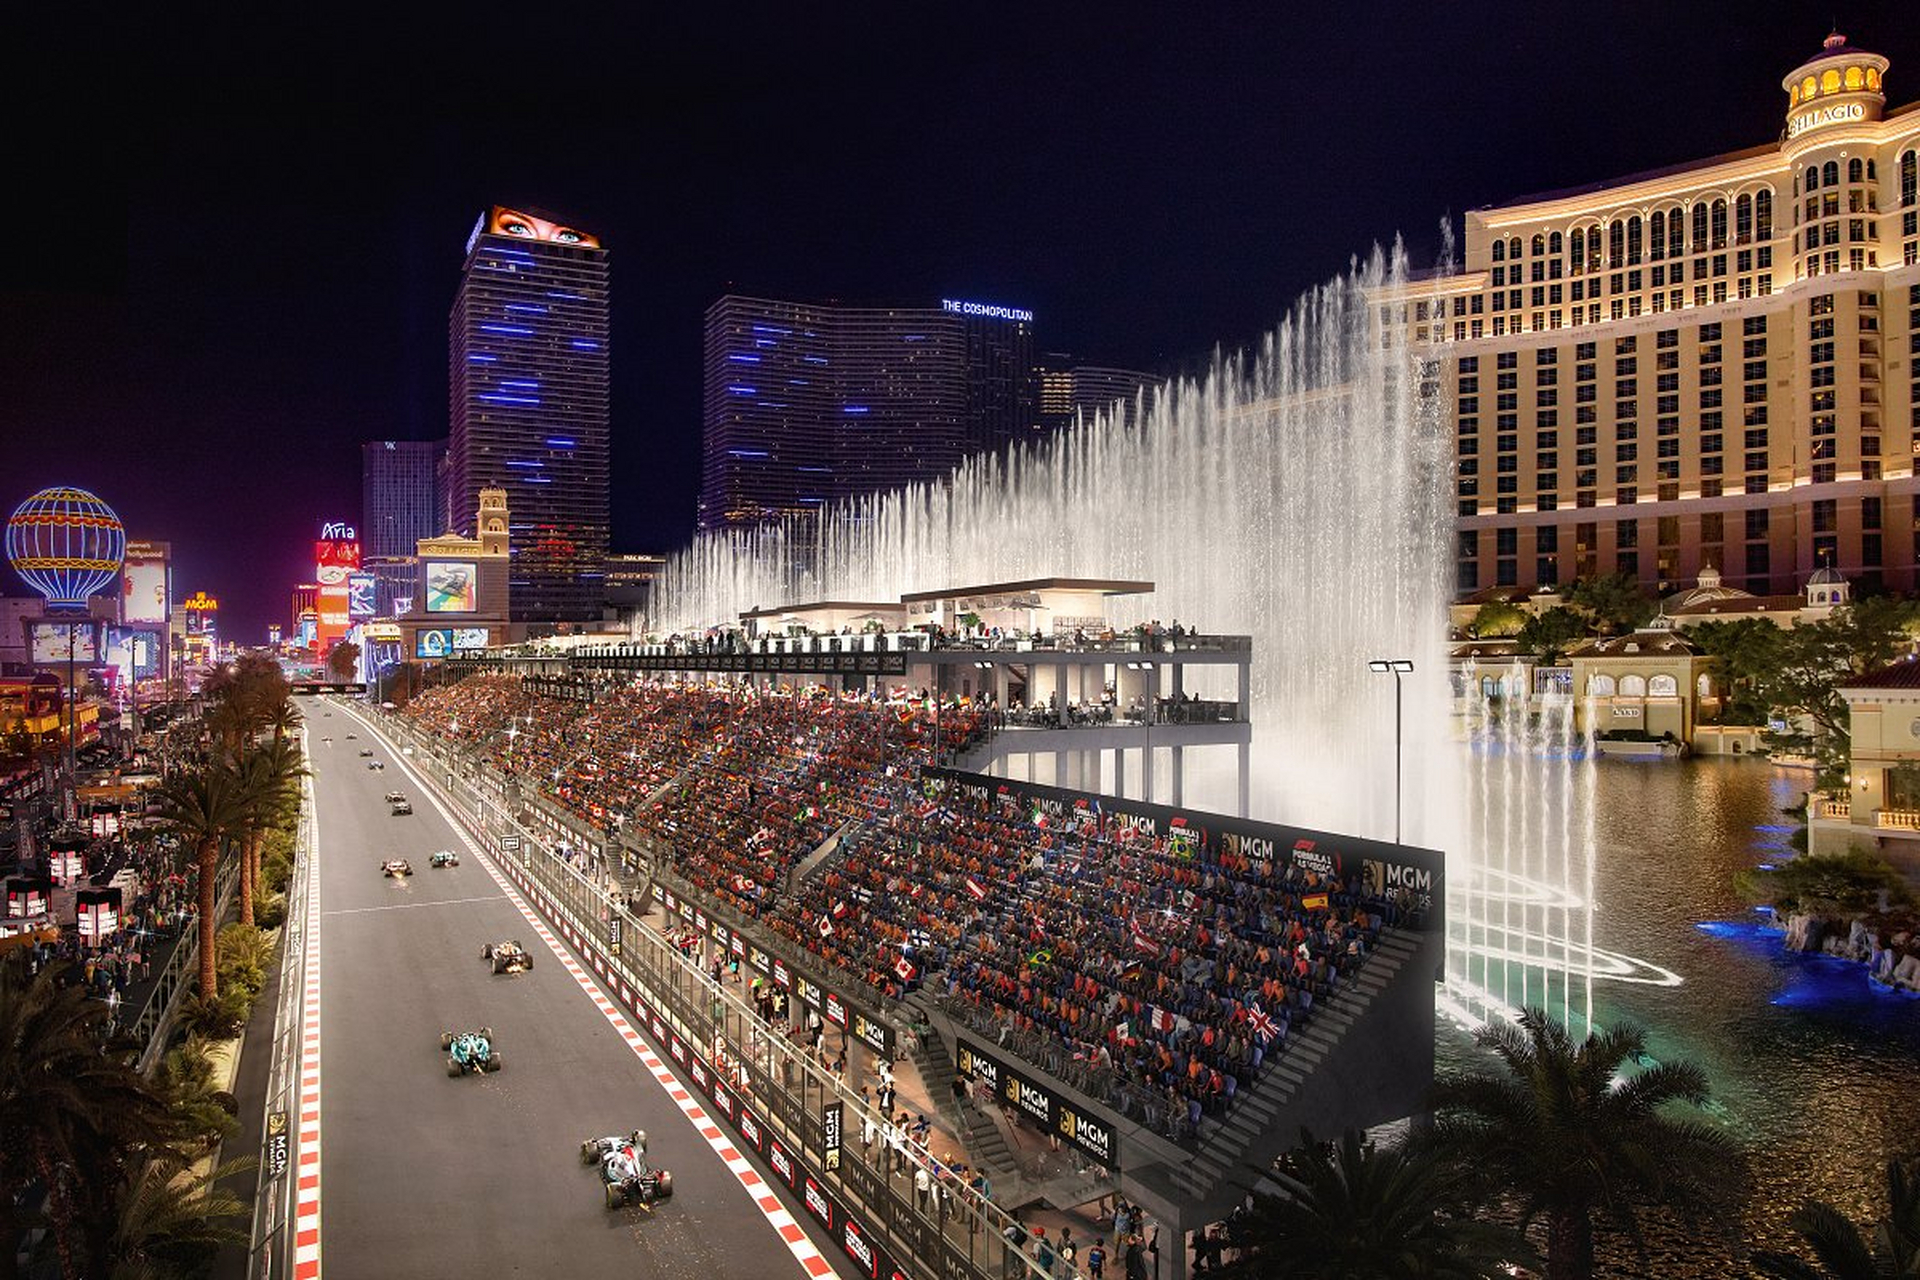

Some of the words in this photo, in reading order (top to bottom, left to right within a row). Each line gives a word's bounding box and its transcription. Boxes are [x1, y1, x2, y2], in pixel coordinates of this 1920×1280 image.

[1788, 103, 1866, 137] BELLAGIO
[942, 299, 961, 312] THE
[963, 302, 1033, 321] COSMOPOLITAN
[321, 522, 355, 540] Aria
[184, 599, 218, 610] MGM
[970, 784, 989, 801] MGM
[1041, 798, 1064, 816] MGM
[1129, 814, 1155, 836] MGM
[1240, 836, 1273, 860] MGM
[1386, 863, 1431, 891] MGM
[972, 1054, 998, 1081] MGM
[1021, 1084, 1049, 1113] MGM
[826, 1110, 835, 1148] MGM
[1076, 1116, 1109, 1149] MGM
[276, 1134, 287, 1173] MGM
